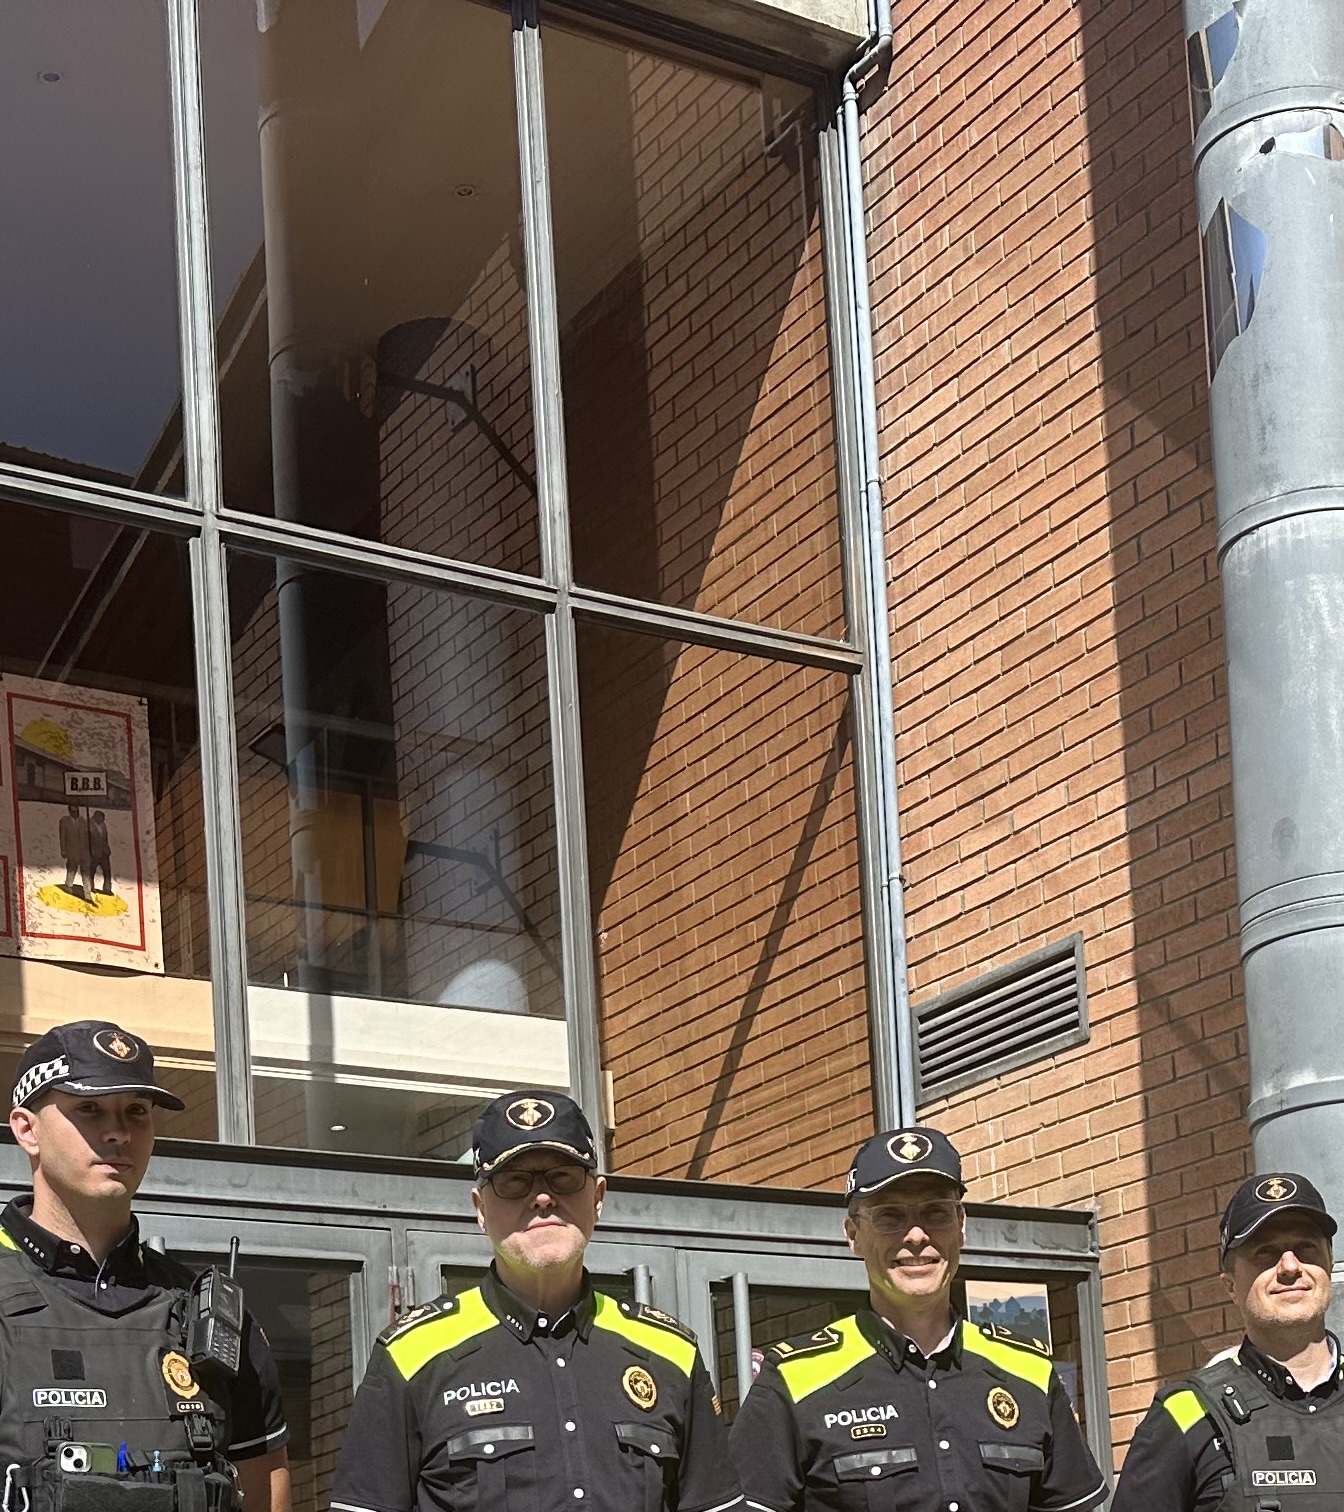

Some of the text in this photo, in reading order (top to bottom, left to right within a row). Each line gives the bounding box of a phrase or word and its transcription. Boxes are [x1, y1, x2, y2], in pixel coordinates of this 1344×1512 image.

[71, 777, 104, 791] B.B.B.
[37, 1390, 103, 1405] POLICIA
[443, 1379, 520, 1405] POLICIA
[824, 1404, 899, 1429] POLICIA
[1256, 1472, 1313, 1484] POLICIA
